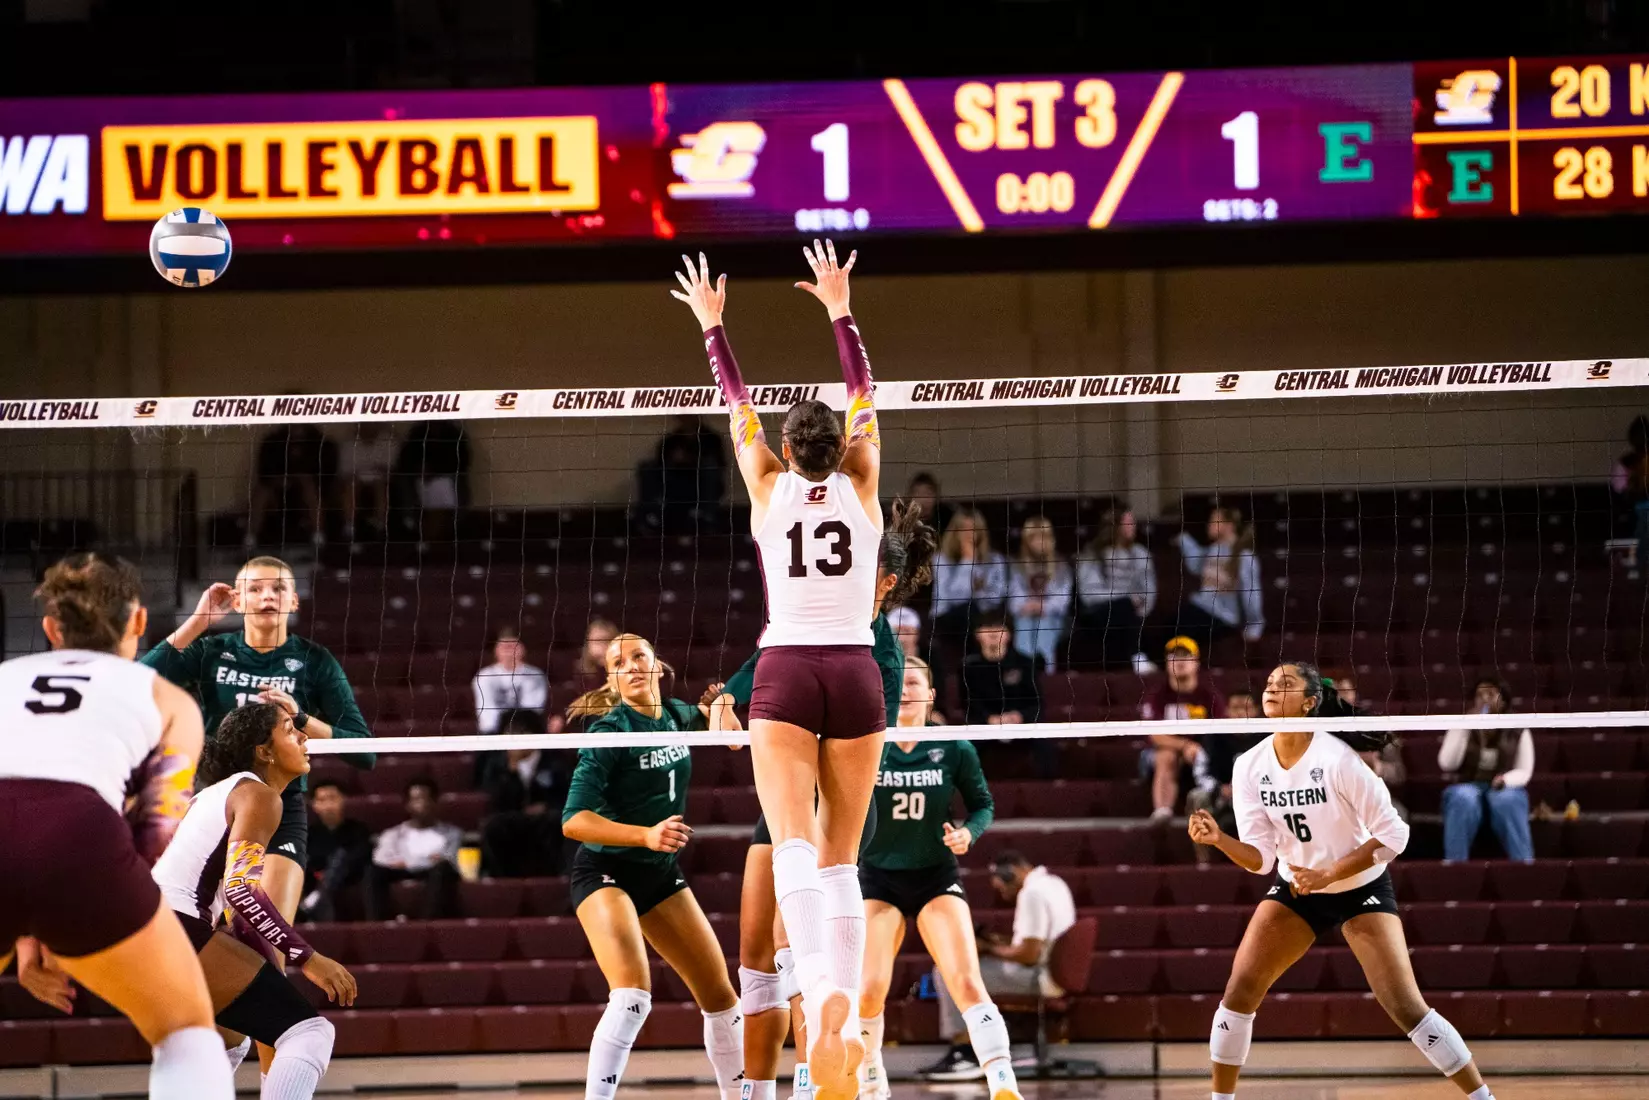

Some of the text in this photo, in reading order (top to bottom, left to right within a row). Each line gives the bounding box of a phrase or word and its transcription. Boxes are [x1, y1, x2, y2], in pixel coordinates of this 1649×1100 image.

[1550, 64, 1611, 118] 20
[954, 79, 1117, 152] SET 3
[123, 135, 571, 203] VOLLEYBALL
[811, 122, 850, 202] 1
[1221, 111, 1260, 190] 1
[1318, 122, 1373, 182] E
[996, 171, 1075, 214] 0:00
[1446, 151, 1493, 203] E
[1553, 146, 1614, 200] 28
[910, 375, 1181, 402] CENTRAL MICHIGAN VOLLEYBALL
[1274, 363, 1552, 391] CENTRAL MICHIGAN VOLLEYBALL
[192, 393, 460, 418] CENTRAL MICHIGAN VOLLEYBALL
[552, 390, 626, 410] CENTRAL
[630, 388, 716, 408] MICHIGAN
[786, 520, 853, 578] 13
[24, 675, 91, 715] 5
[216, 665, 297, 694] EASTERN
[668, 768, 676, 802] 1
[891, 791, 926, 820] 20
[1260, 786, 1328, 807] EASTERN
[1283, 812, 1313, 843] 16
[225, 876, 289, 946] CHIPPEWAS
